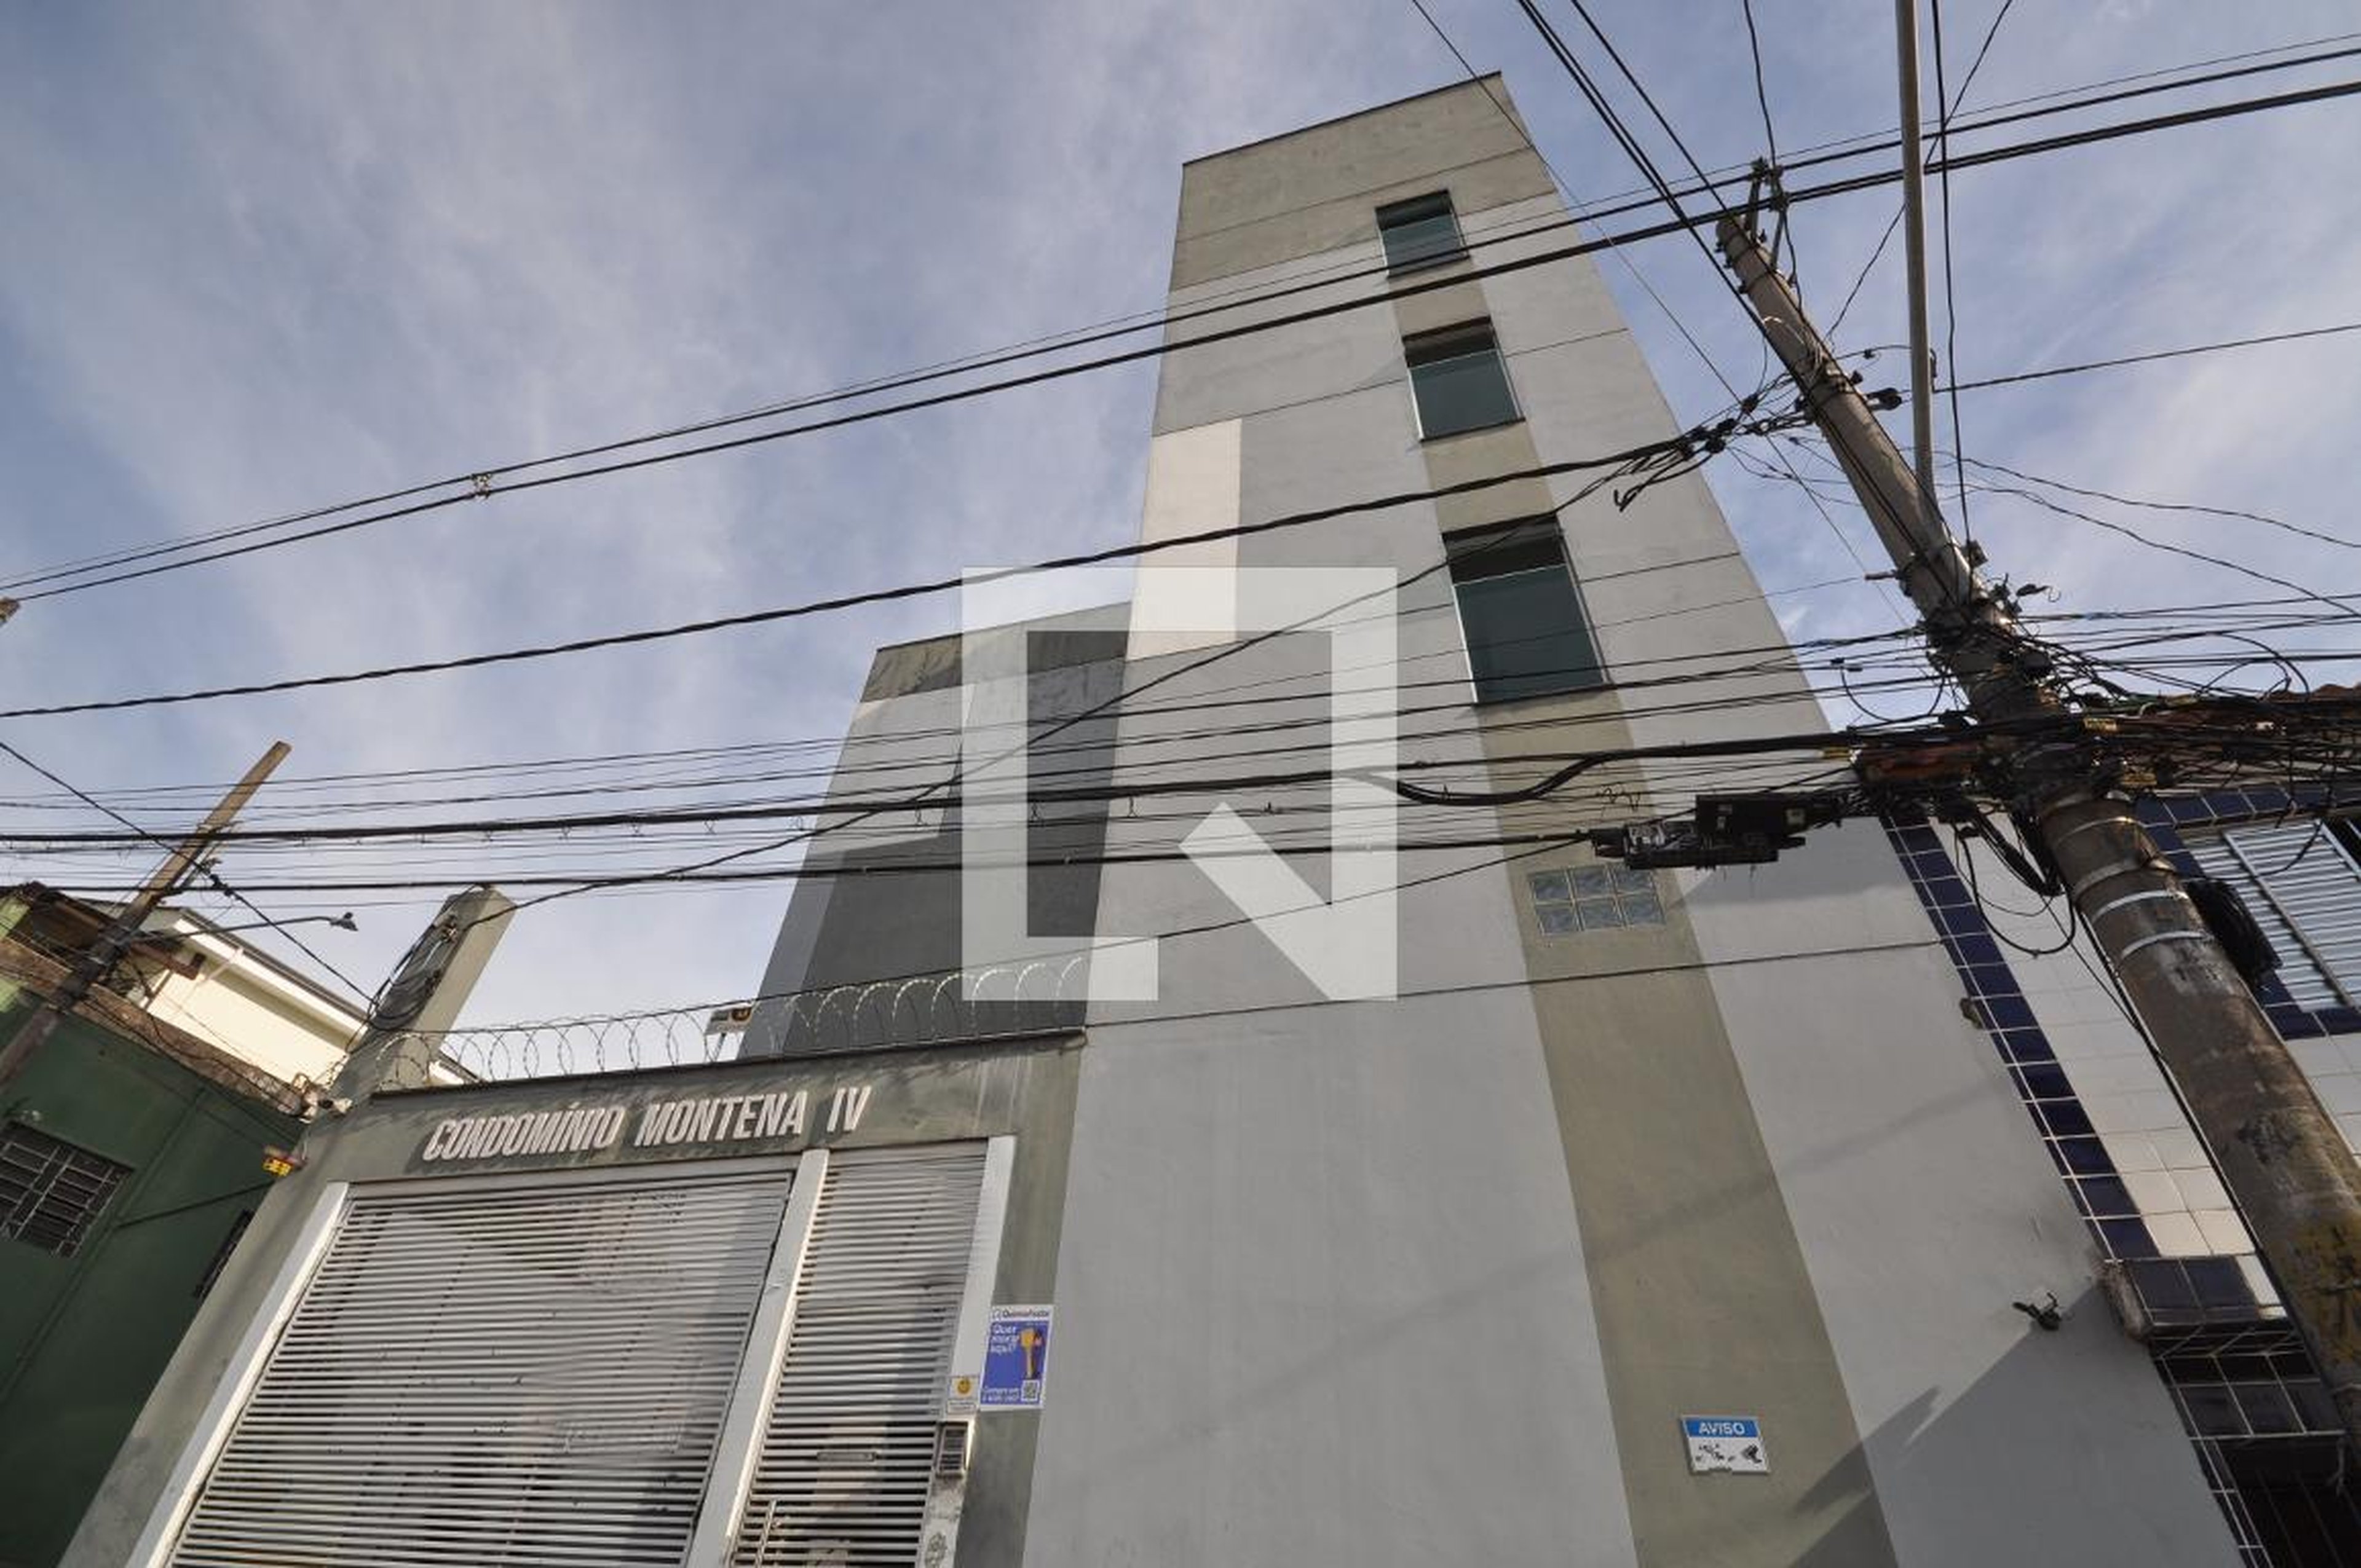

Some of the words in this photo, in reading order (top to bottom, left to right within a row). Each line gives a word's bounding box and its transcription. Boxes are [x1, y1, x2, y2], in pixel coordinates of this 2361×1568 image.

[422, 1101, 626, 1160] CONDOMÍNIO
[633, 1090, 808, 1147] MONTENA
[826, 1085, 872, 1132] IV
[1699, 1422, 1745, 1435] AVISO
